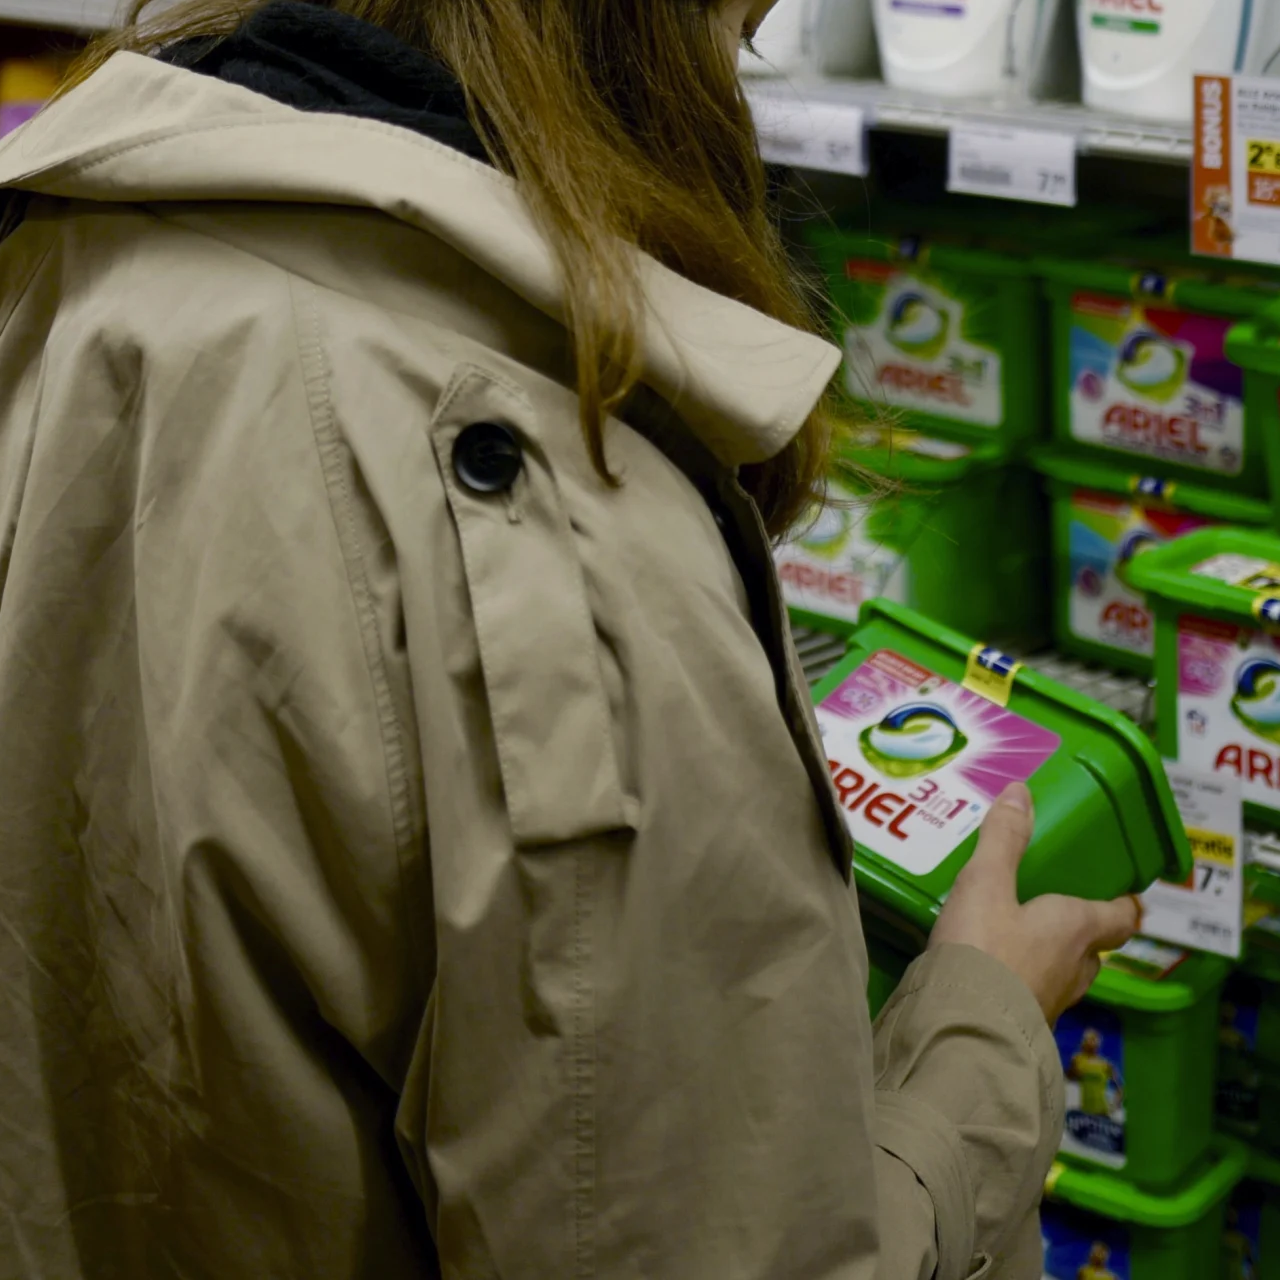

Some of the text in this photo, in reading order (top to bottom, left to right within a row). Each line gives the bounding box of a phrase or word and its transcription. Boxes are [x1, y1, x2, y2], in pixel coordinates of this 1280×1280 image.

[1200, 80, 1223, 170] BONUS
[877, 364, 973, 408] ARIEL
[1099, 404, 1210, 455] ARIEL
[908, 778, 969, 821] 3in1
[917, 808, 946, 830] PODS
